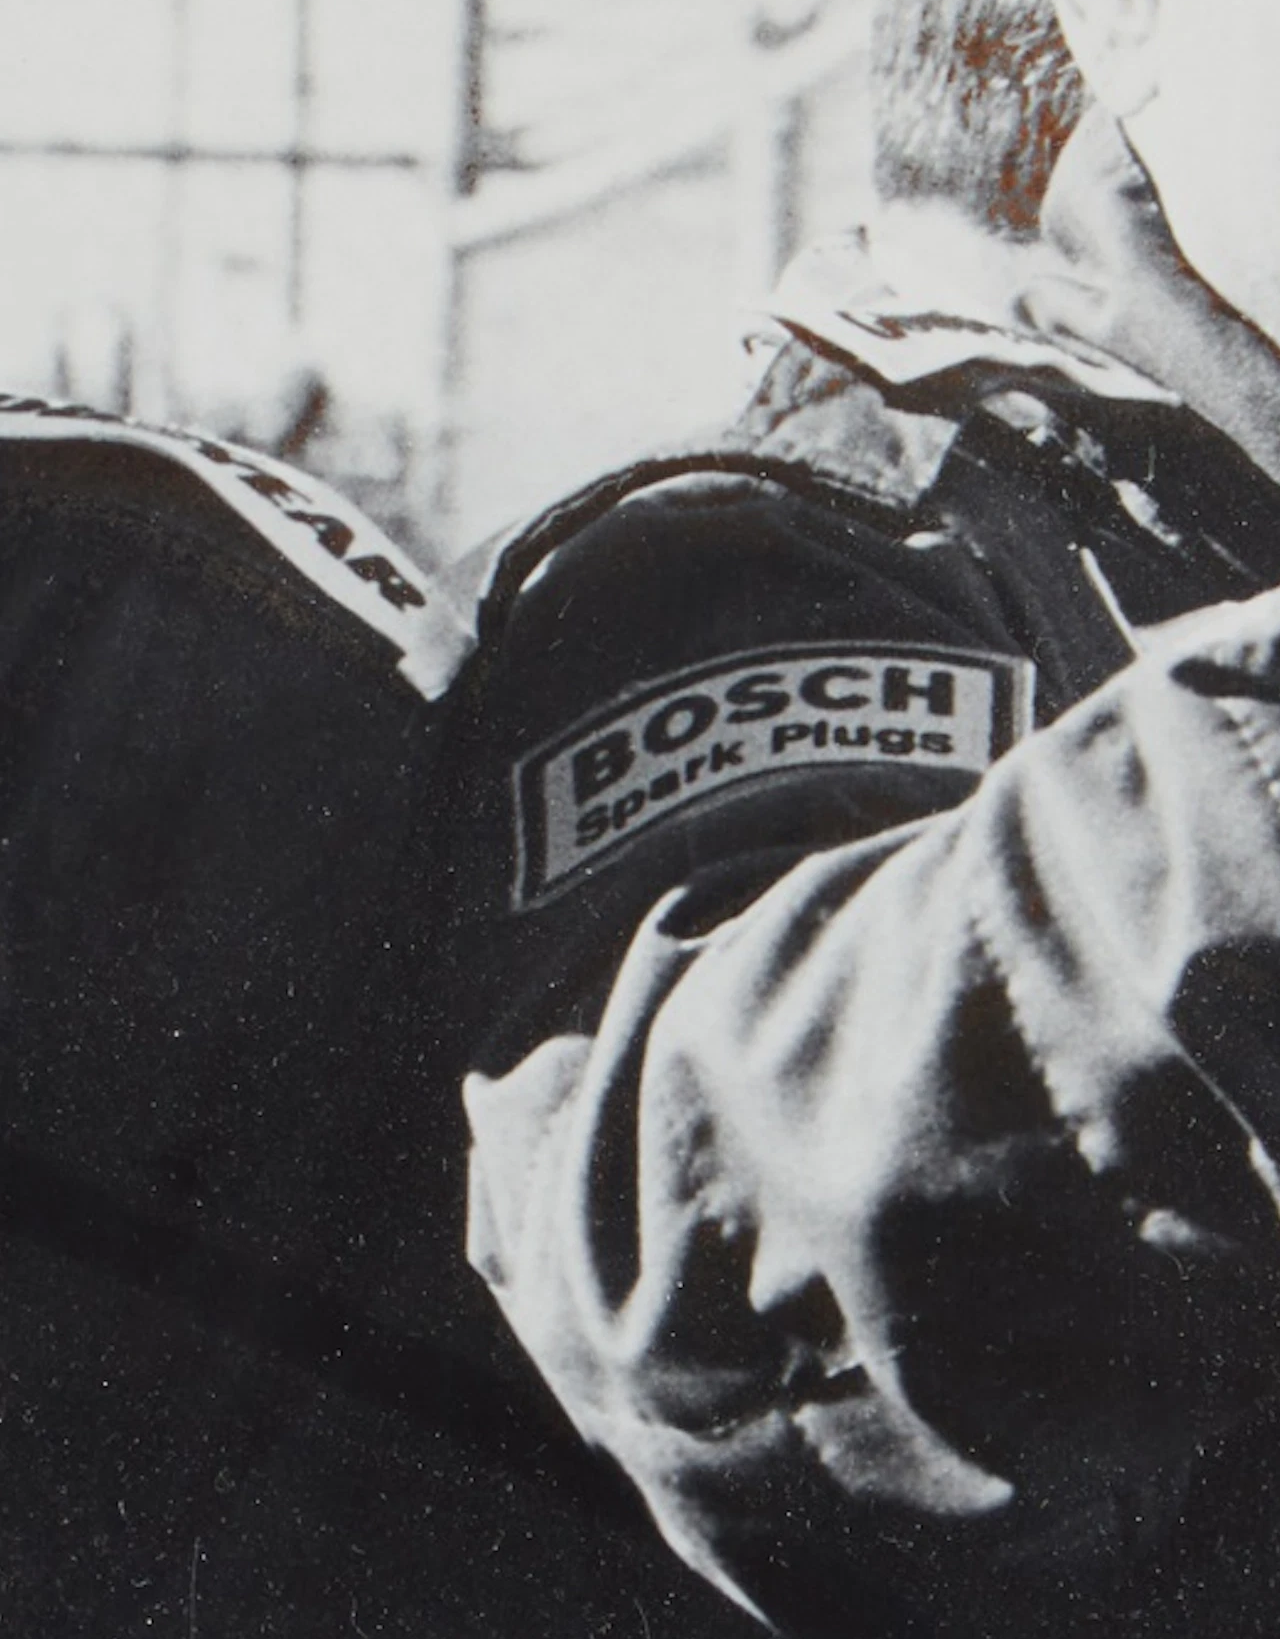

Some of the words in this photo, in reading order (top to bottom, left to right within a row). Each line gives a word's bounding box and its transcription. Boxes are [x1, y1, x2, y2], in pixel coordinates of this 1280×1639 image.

[572, 665, 956, 807] BOSCH
[574, 739, 746, 847] Spark
[770, 719, 956, 755] Plugs
